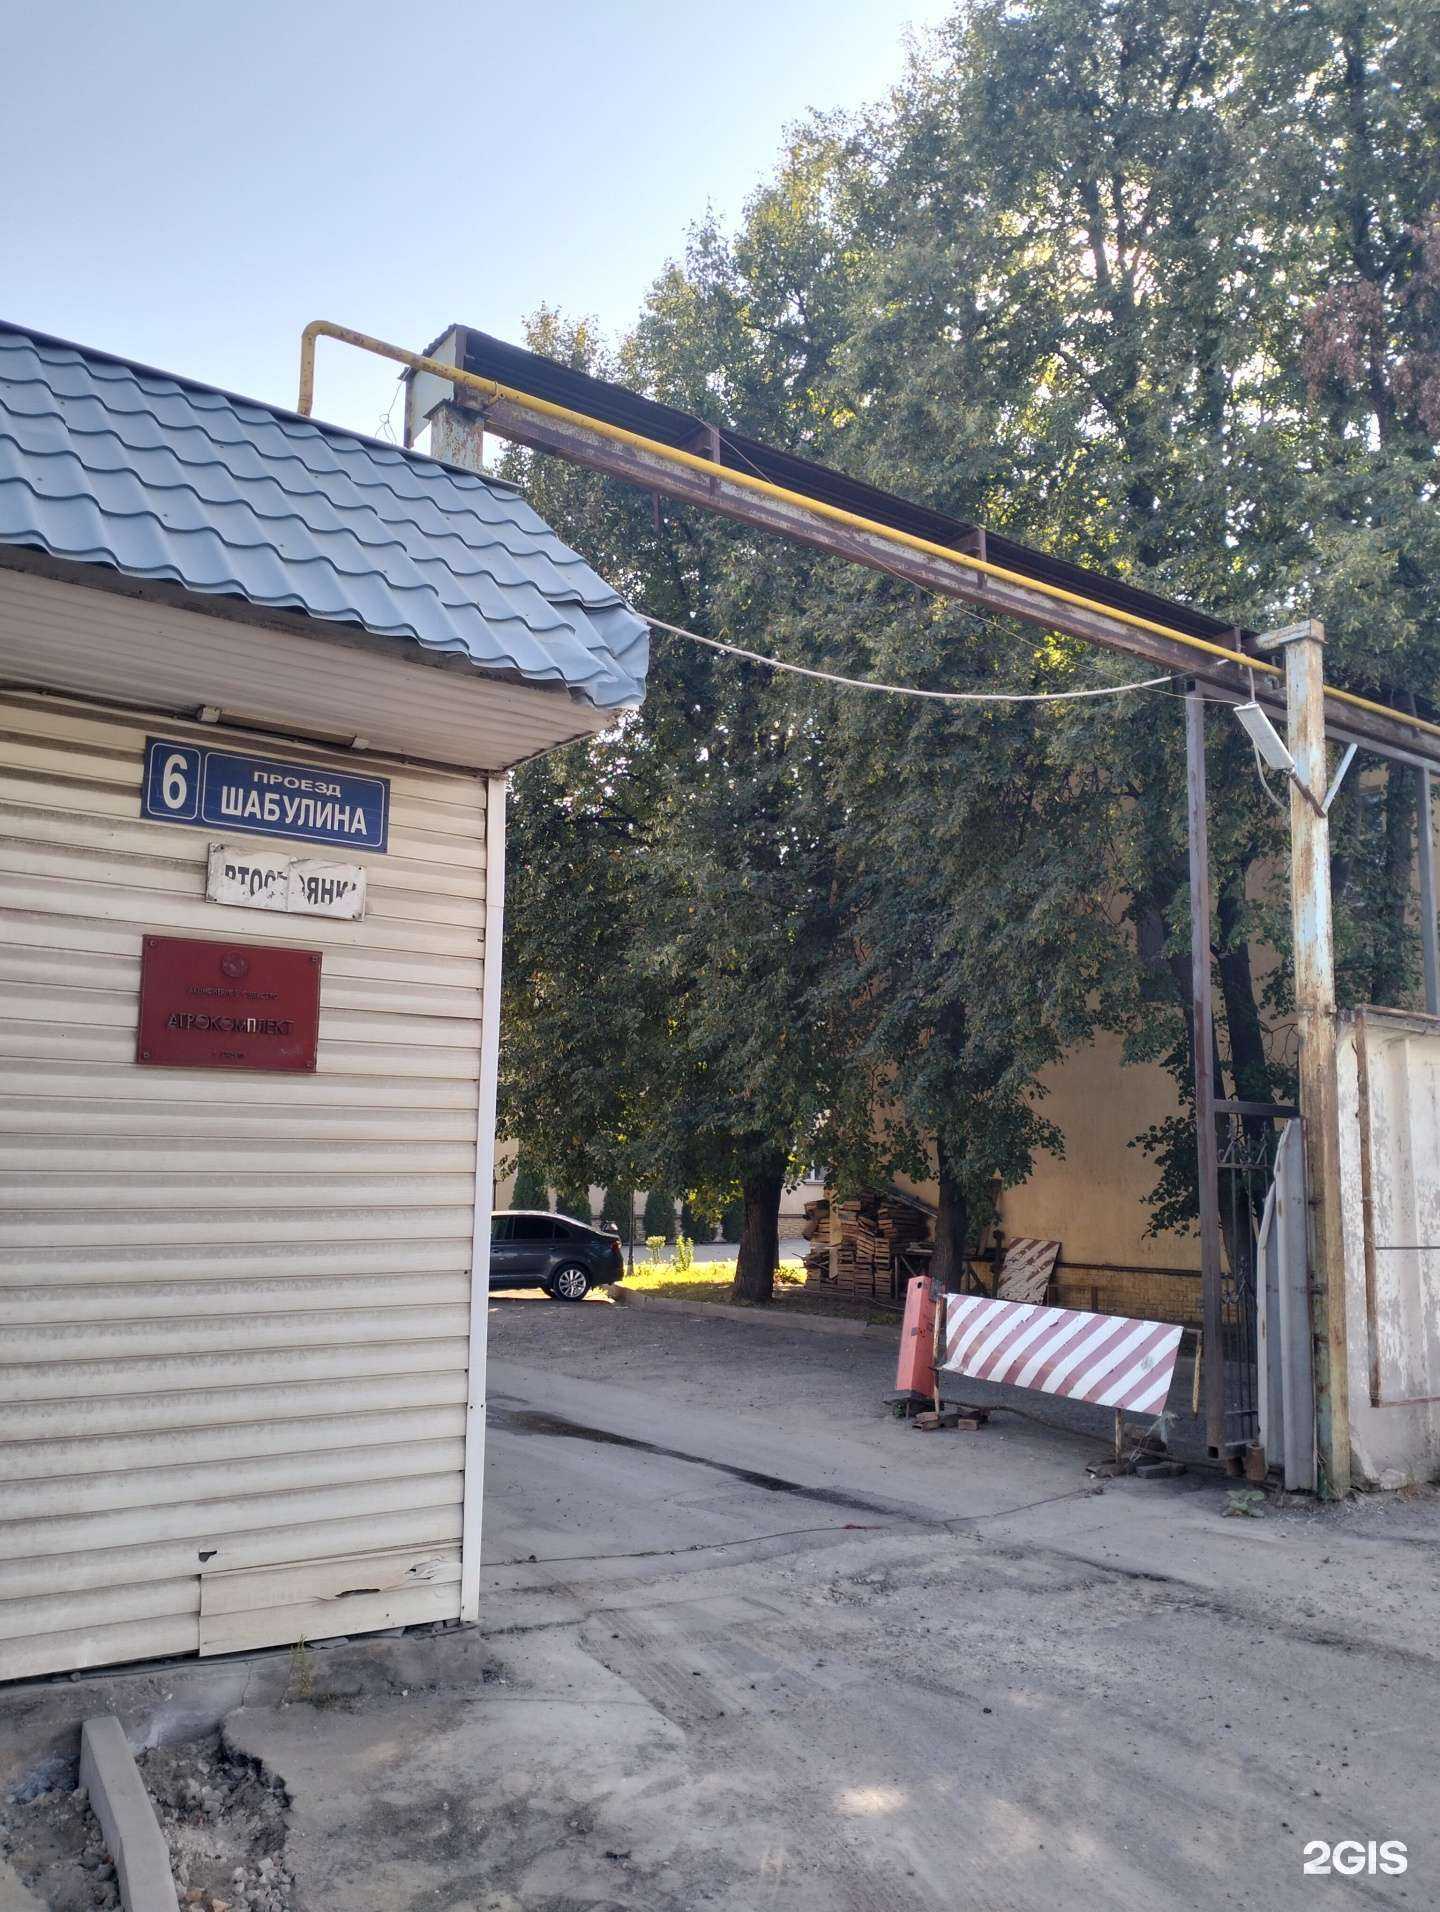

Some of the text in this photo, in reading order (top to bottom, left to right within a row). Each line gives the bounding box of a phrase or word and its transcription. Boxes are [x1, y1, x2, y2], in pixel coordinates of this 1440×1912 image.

[162, 754, 188, 809] 6
[253, 771, 342, 798] ПРОЕЗД
[221, 785, 368, 836] ШАБУЛИНА
